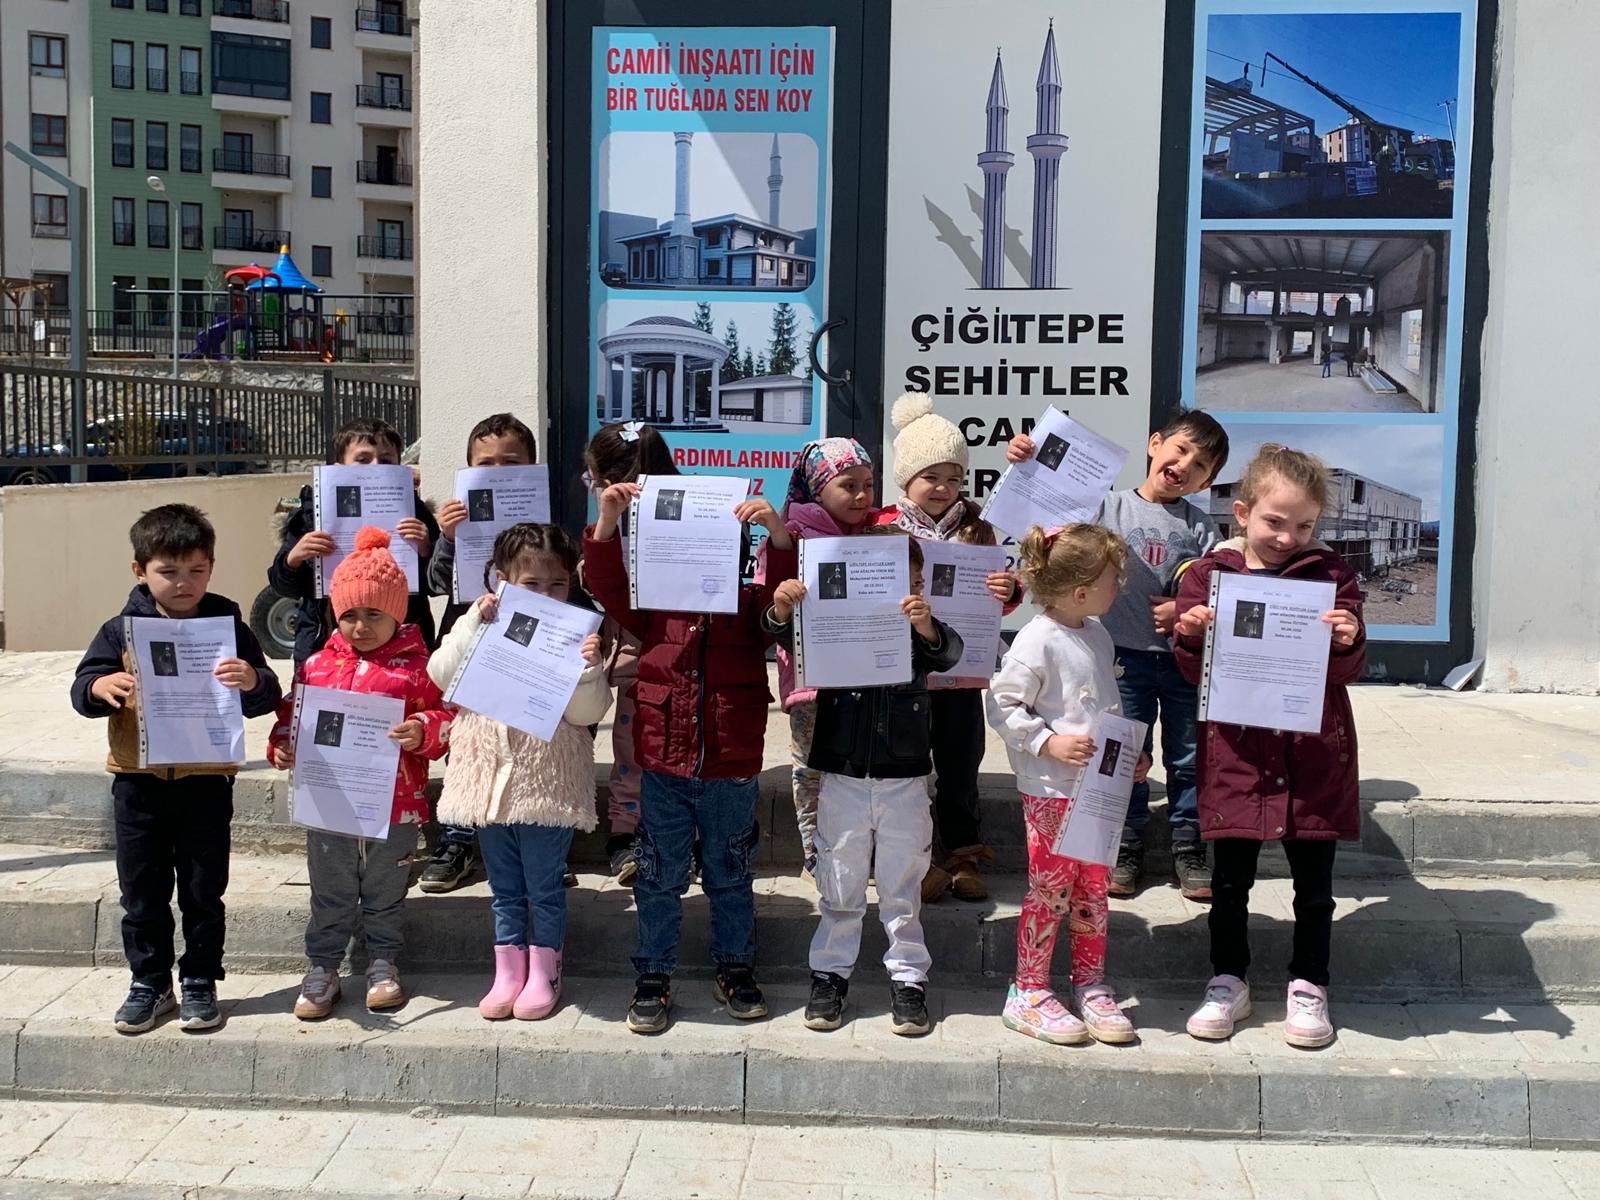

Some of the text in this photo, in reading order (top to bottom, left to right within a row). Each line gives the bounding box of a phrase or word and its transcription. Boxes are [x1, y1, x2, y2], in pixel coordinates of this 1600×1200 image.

[606, 41, 815, 83] CAMİİ İNŞAATI İÇİN
[606, 81, 813, 113] BİR TUĞLADA SEN KOY
[911, 306, 1124, 352] ÇİĞİLTEPE
